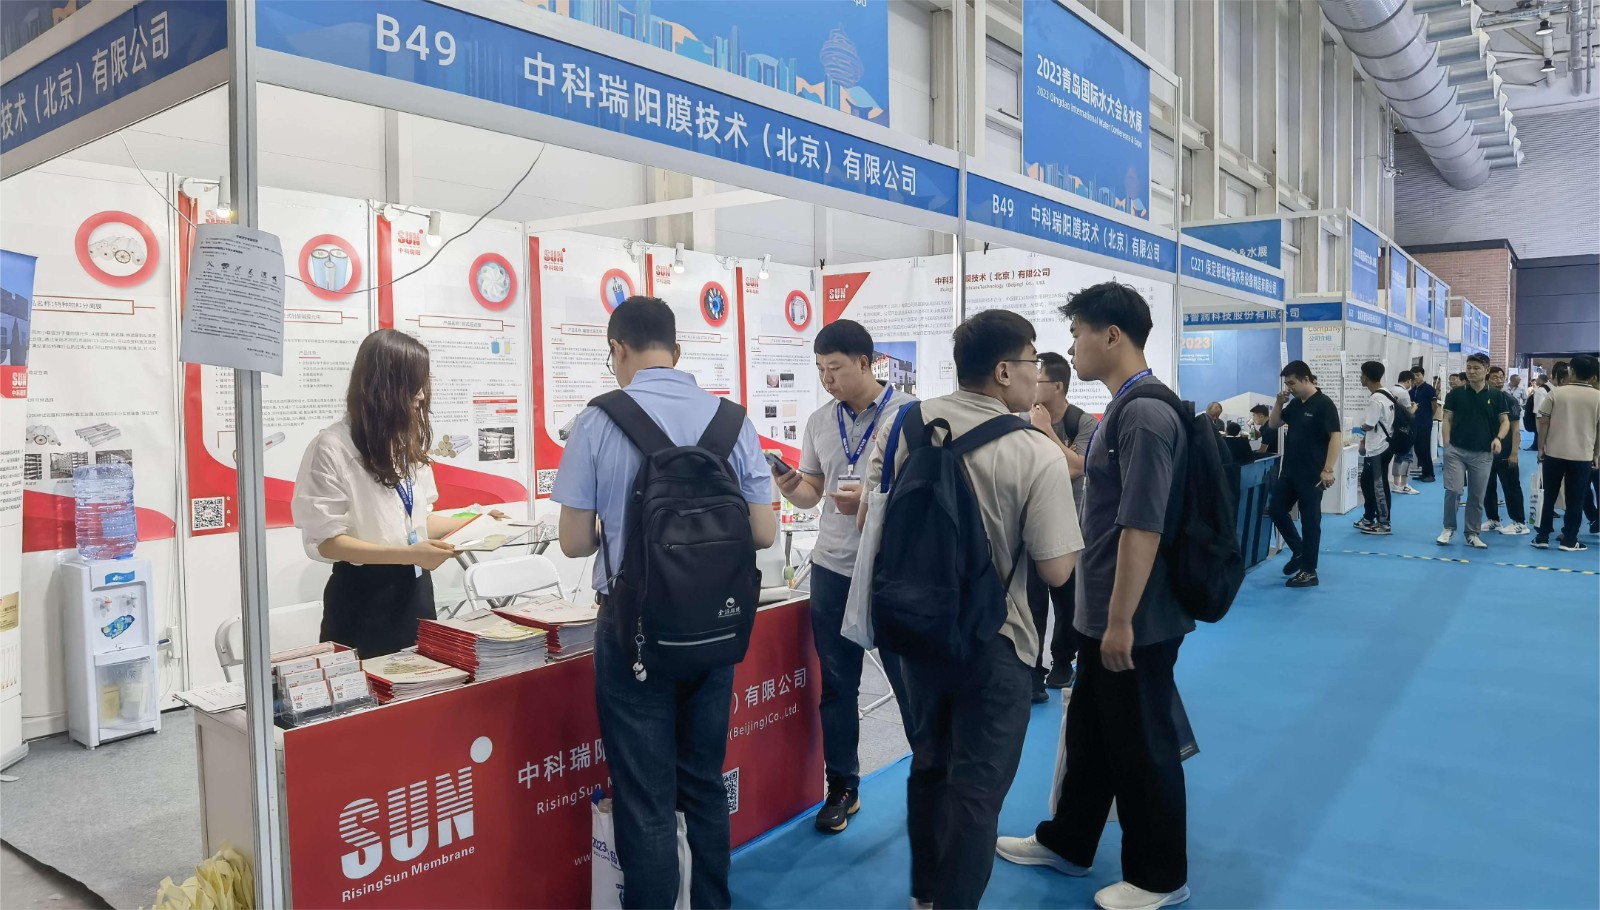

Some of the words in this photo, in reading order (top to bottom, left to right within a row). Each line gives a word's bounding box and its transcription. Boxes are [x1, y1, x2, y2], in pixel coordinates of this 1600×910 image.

[376, 13, 457, 66] B49
[523, 51, 917, 196] 中科瑞阳膜技术（北京）有限公司
[1036, 53, 1143, 134] 2023青岛国际水大会&水展
[1037, 85, 1049, 100] 2023
[1049, 92, 1071, 110] Qingdao
[1070, 102, 1099, 124] International
[992, 193, 1015, 218] B49
[1031, 203, 1160, 263] 中科瑞阳膜技术（北京）有限公司
[543, 249, 564, 263] SUN
[1190, 256, 1204, 272] C221
[829, 288, 846, 299] SUN
[934, 267, 1051, 286] 中科瑞膜技术（北京）有限公司
[537, 783, 602, 816] RisingSun
[338, 766, 475, 880] SUN
[341, 871, 409, 903] RisingSun
[410, 846, 475, 877] Membrane
